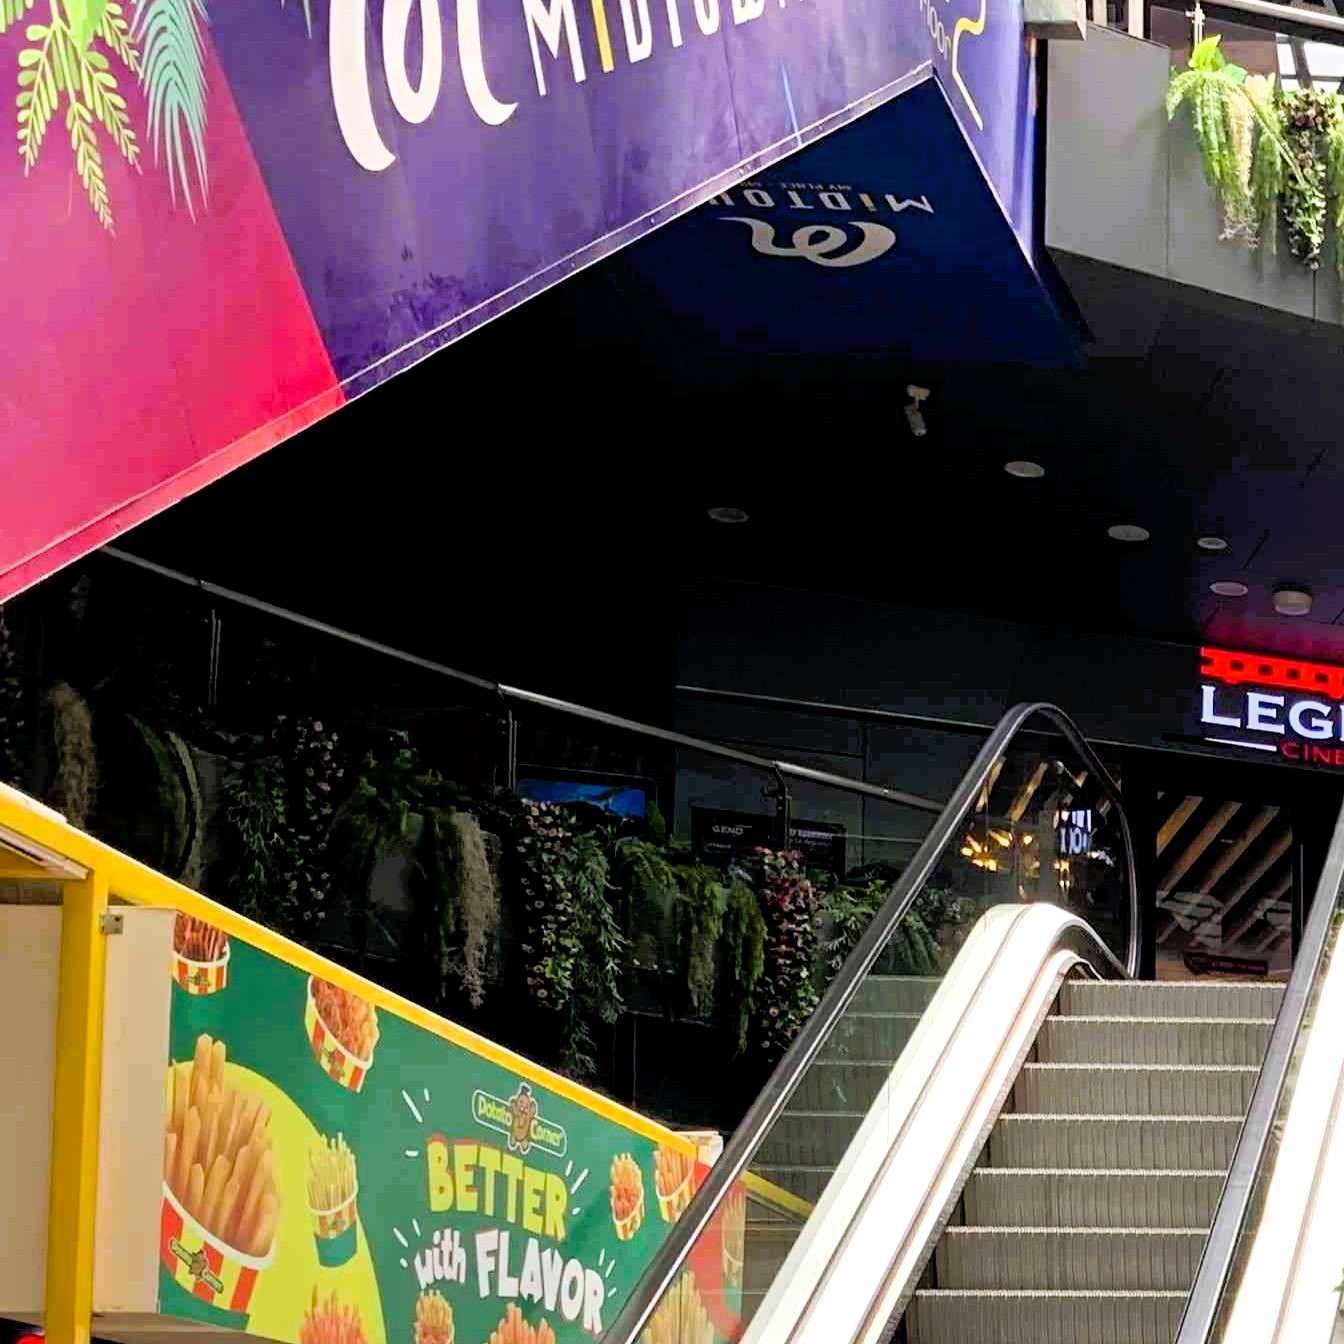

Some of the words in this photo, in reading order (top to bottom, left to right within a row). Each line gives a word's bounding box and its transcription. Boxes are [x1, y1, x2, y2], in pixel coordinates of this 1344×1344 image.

[477, 1095, 513, 1126] Potato
[529, 1118, 562, 1146] Corner
[427, 1137, 568, 1242] BETTER
[414, 1227, 467, 1289] with
[475, 1229, 605, 1335] FLAVOR
